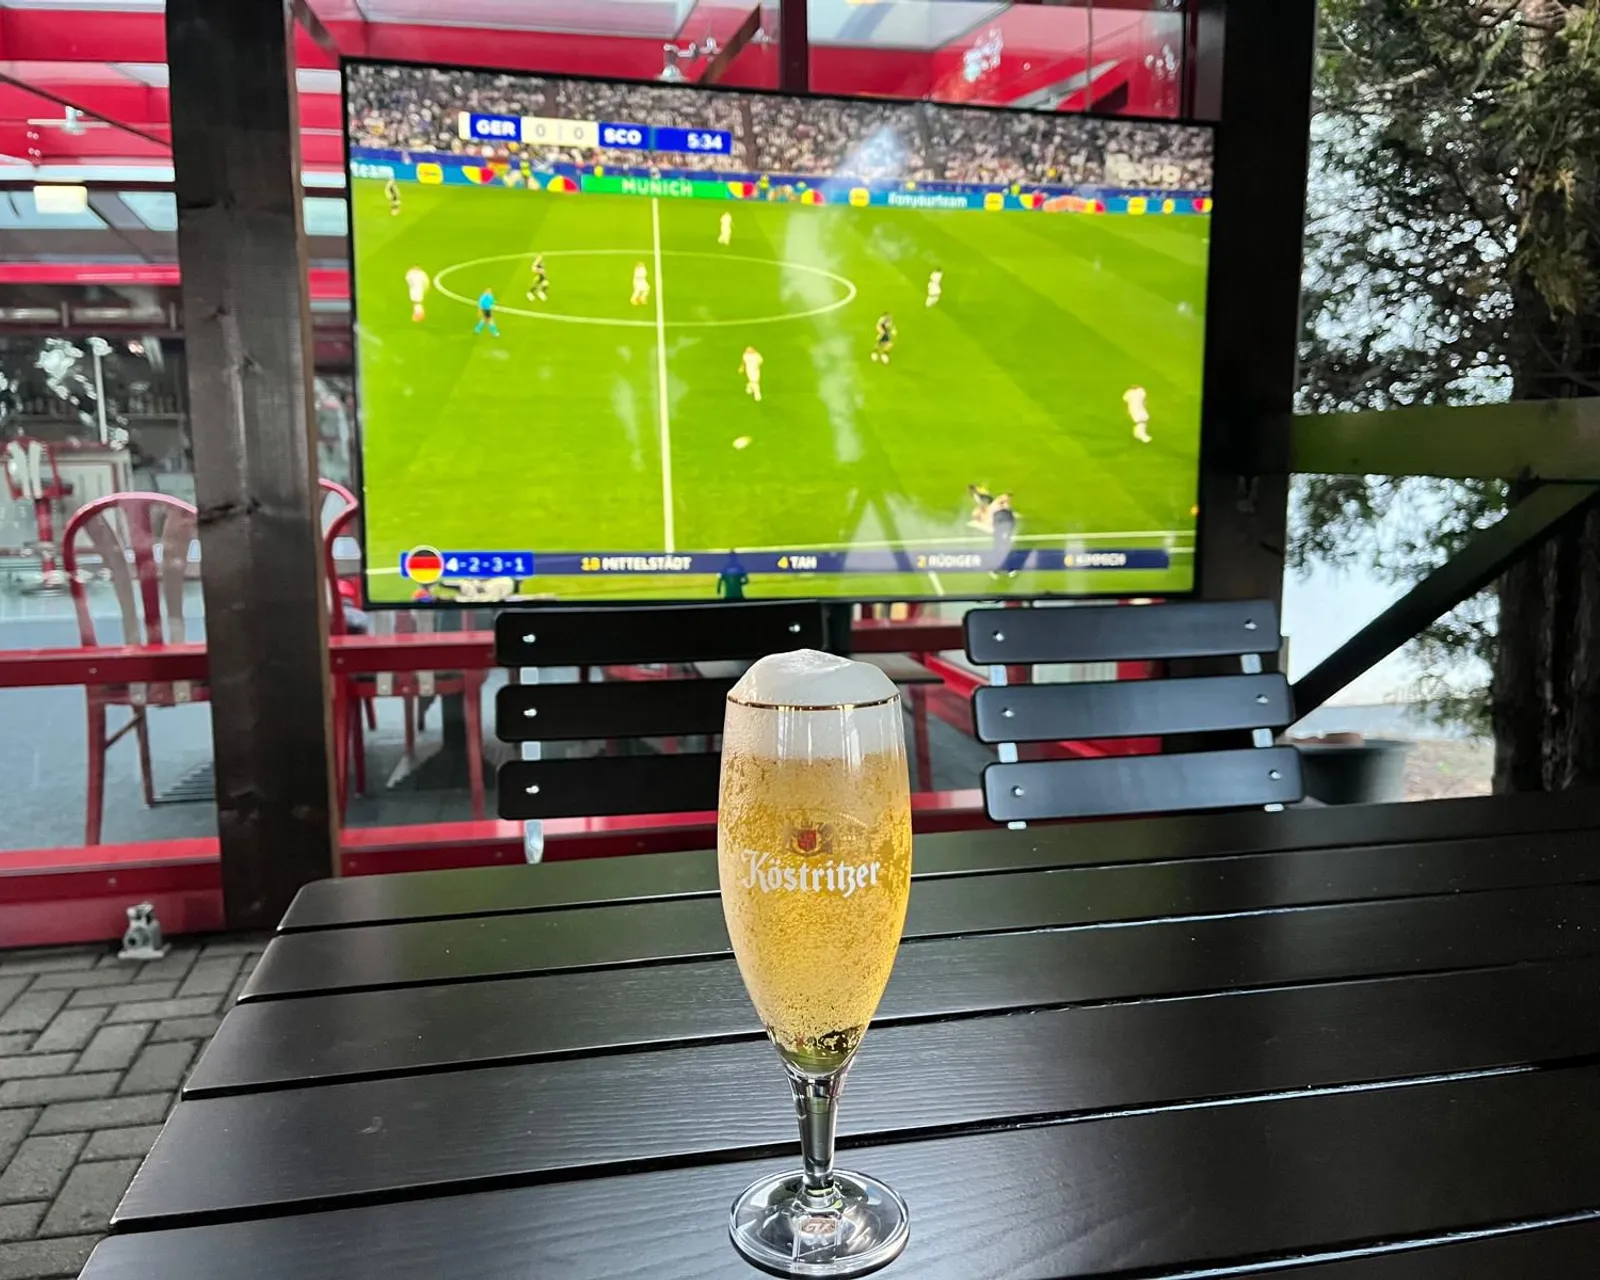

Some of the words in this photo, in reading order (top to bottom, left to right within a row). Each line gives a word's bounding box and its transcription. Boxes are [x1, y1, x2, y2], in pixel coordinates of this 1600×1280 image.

[475, 118, 516, 137] GER
[603, 127, 642, 145] SCO
[687, 133, 723, 149] 5:34
[621, 178, 693, 197] MUNICH
[777, 555, 788, 569] 4
[741, 850, 881, 899] Köstritzer
